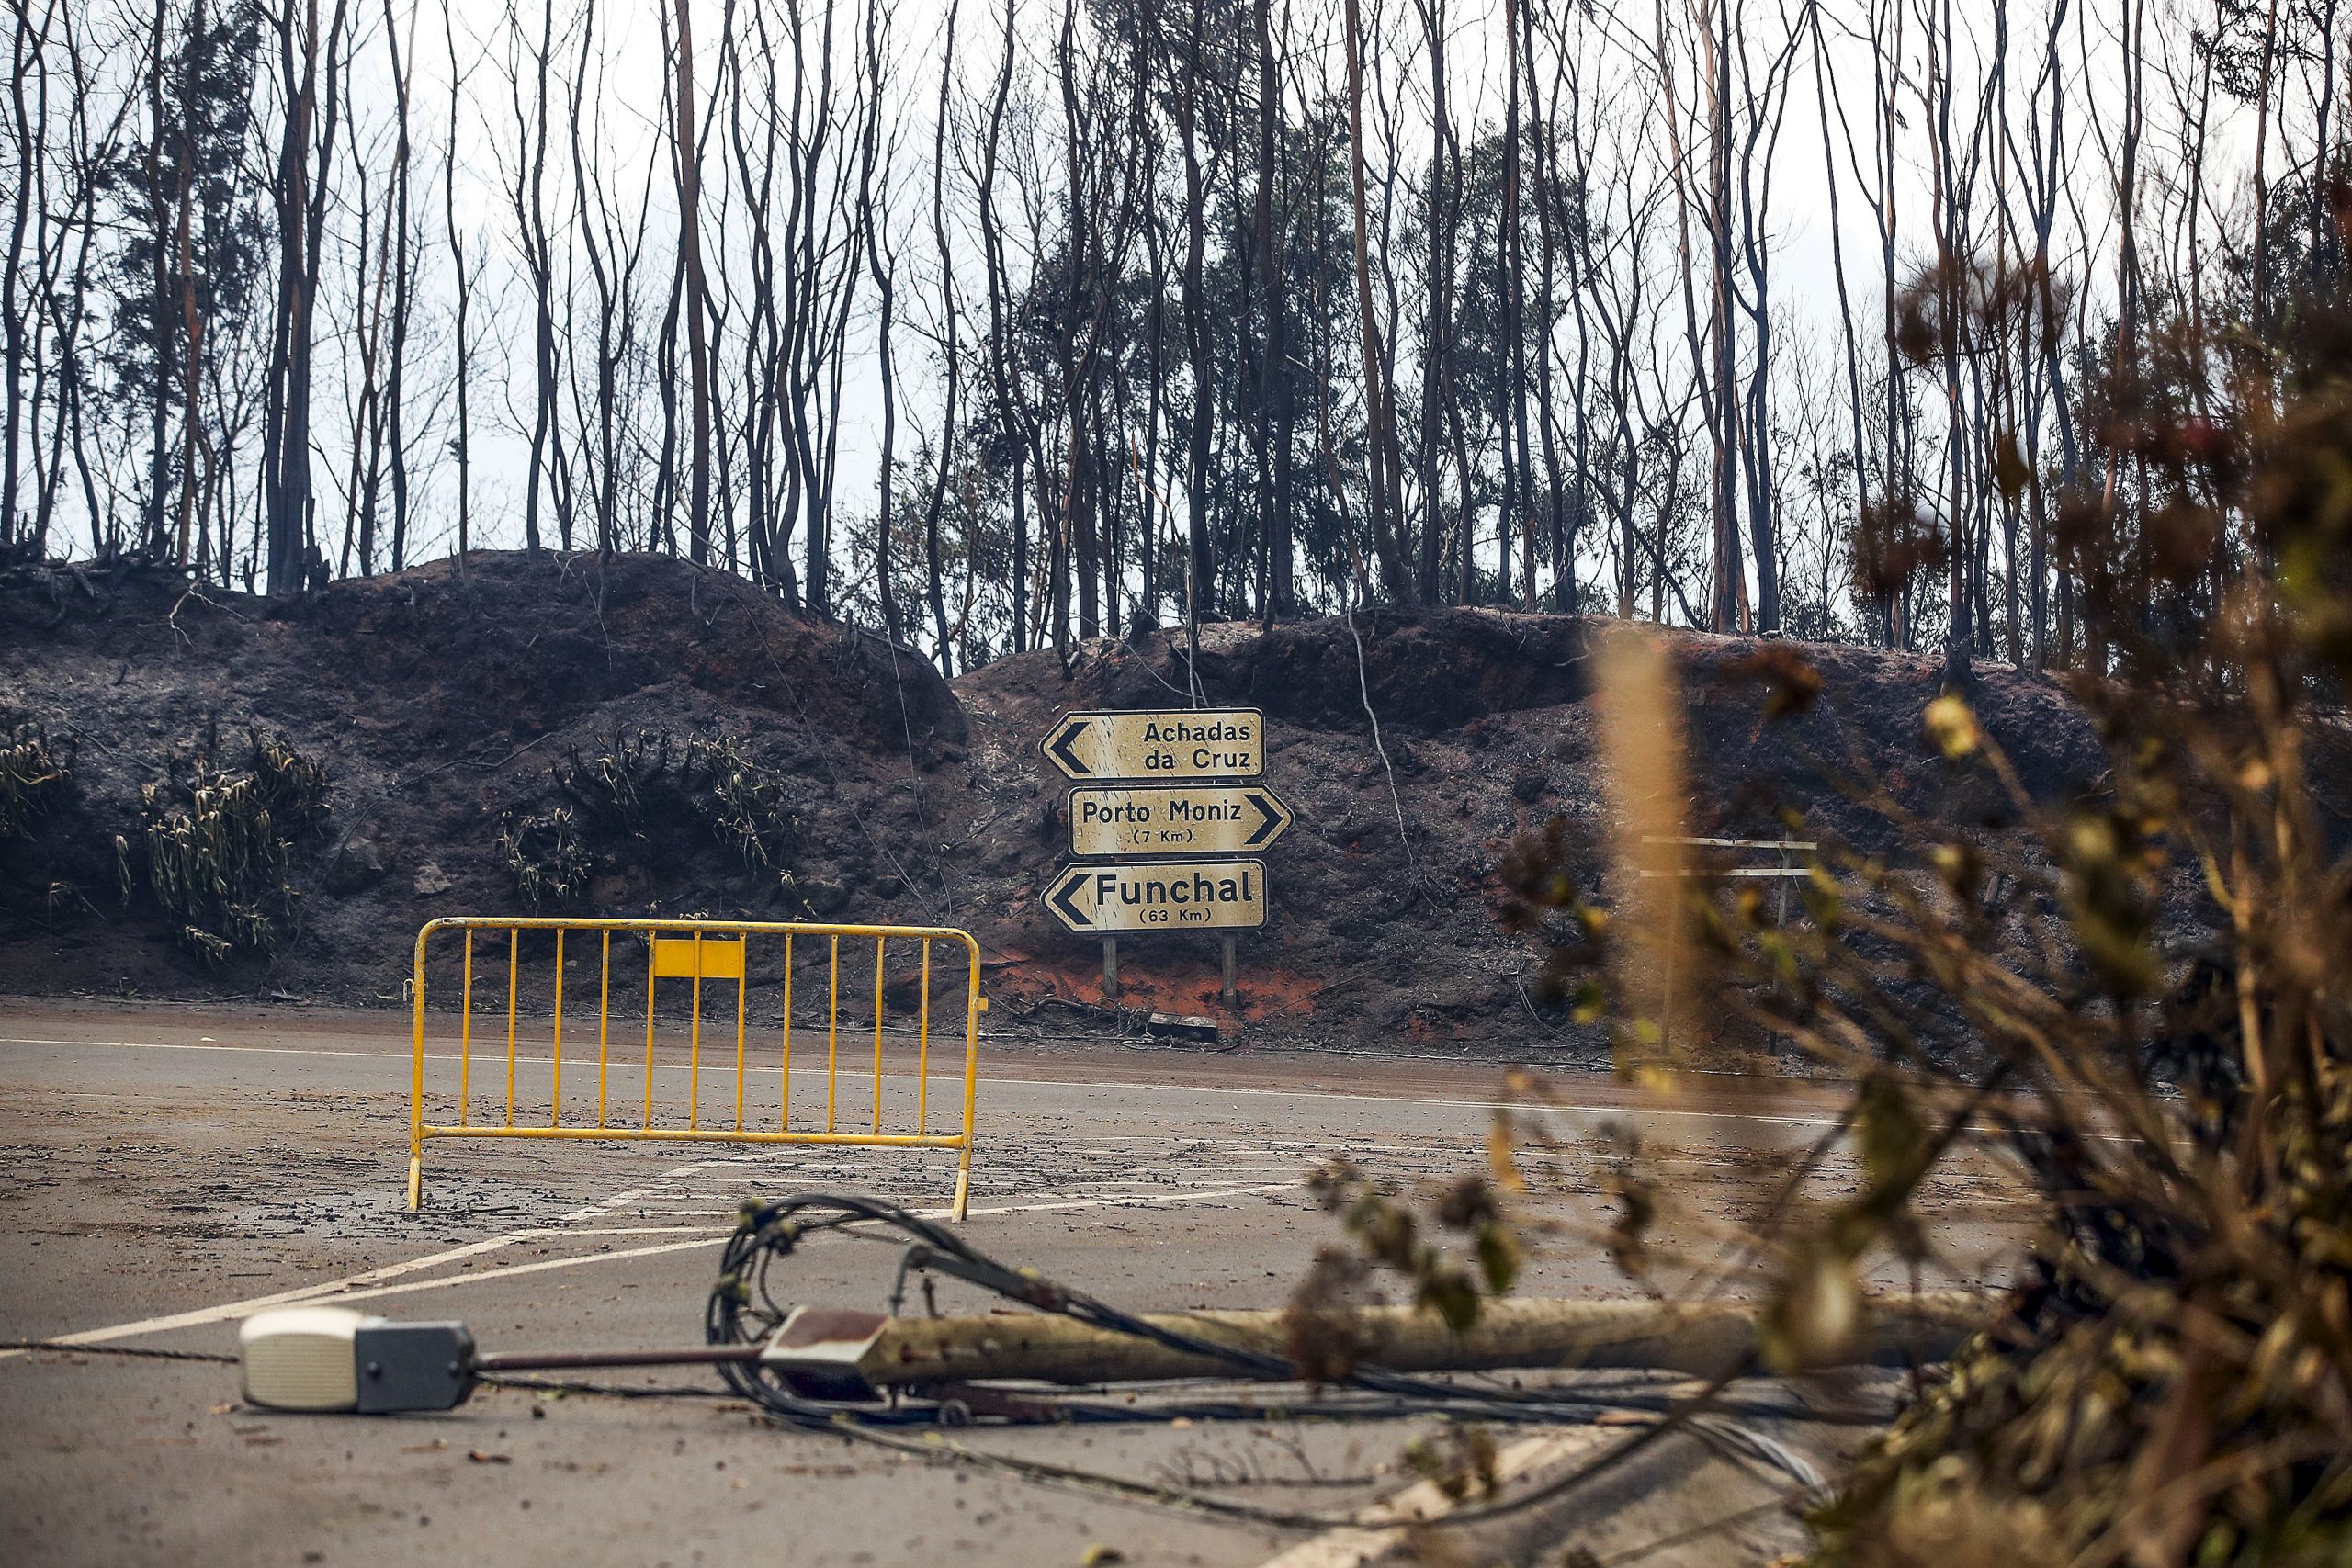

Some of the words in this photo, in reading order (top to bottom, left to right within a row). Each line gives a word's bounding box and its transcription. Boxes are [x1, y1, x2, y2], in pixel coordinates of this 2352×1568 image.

[1144, 720, 1250, 742] Achadas
[1145, 750, 1174, 770] da
[1193, 749, 1250, 769] Cruz
[1082, 801, 1150, 823] Porto
[1169, 799, 1241, 821] Moniz
[1133, 830, 1150, 844] (7
[1160, 829, 1193, 843] Km)
[1097, 871, 1252, 906] Funchal
[1139, 910, 1168, 925] (63
[1179, 908, 1212, 922] Km)
